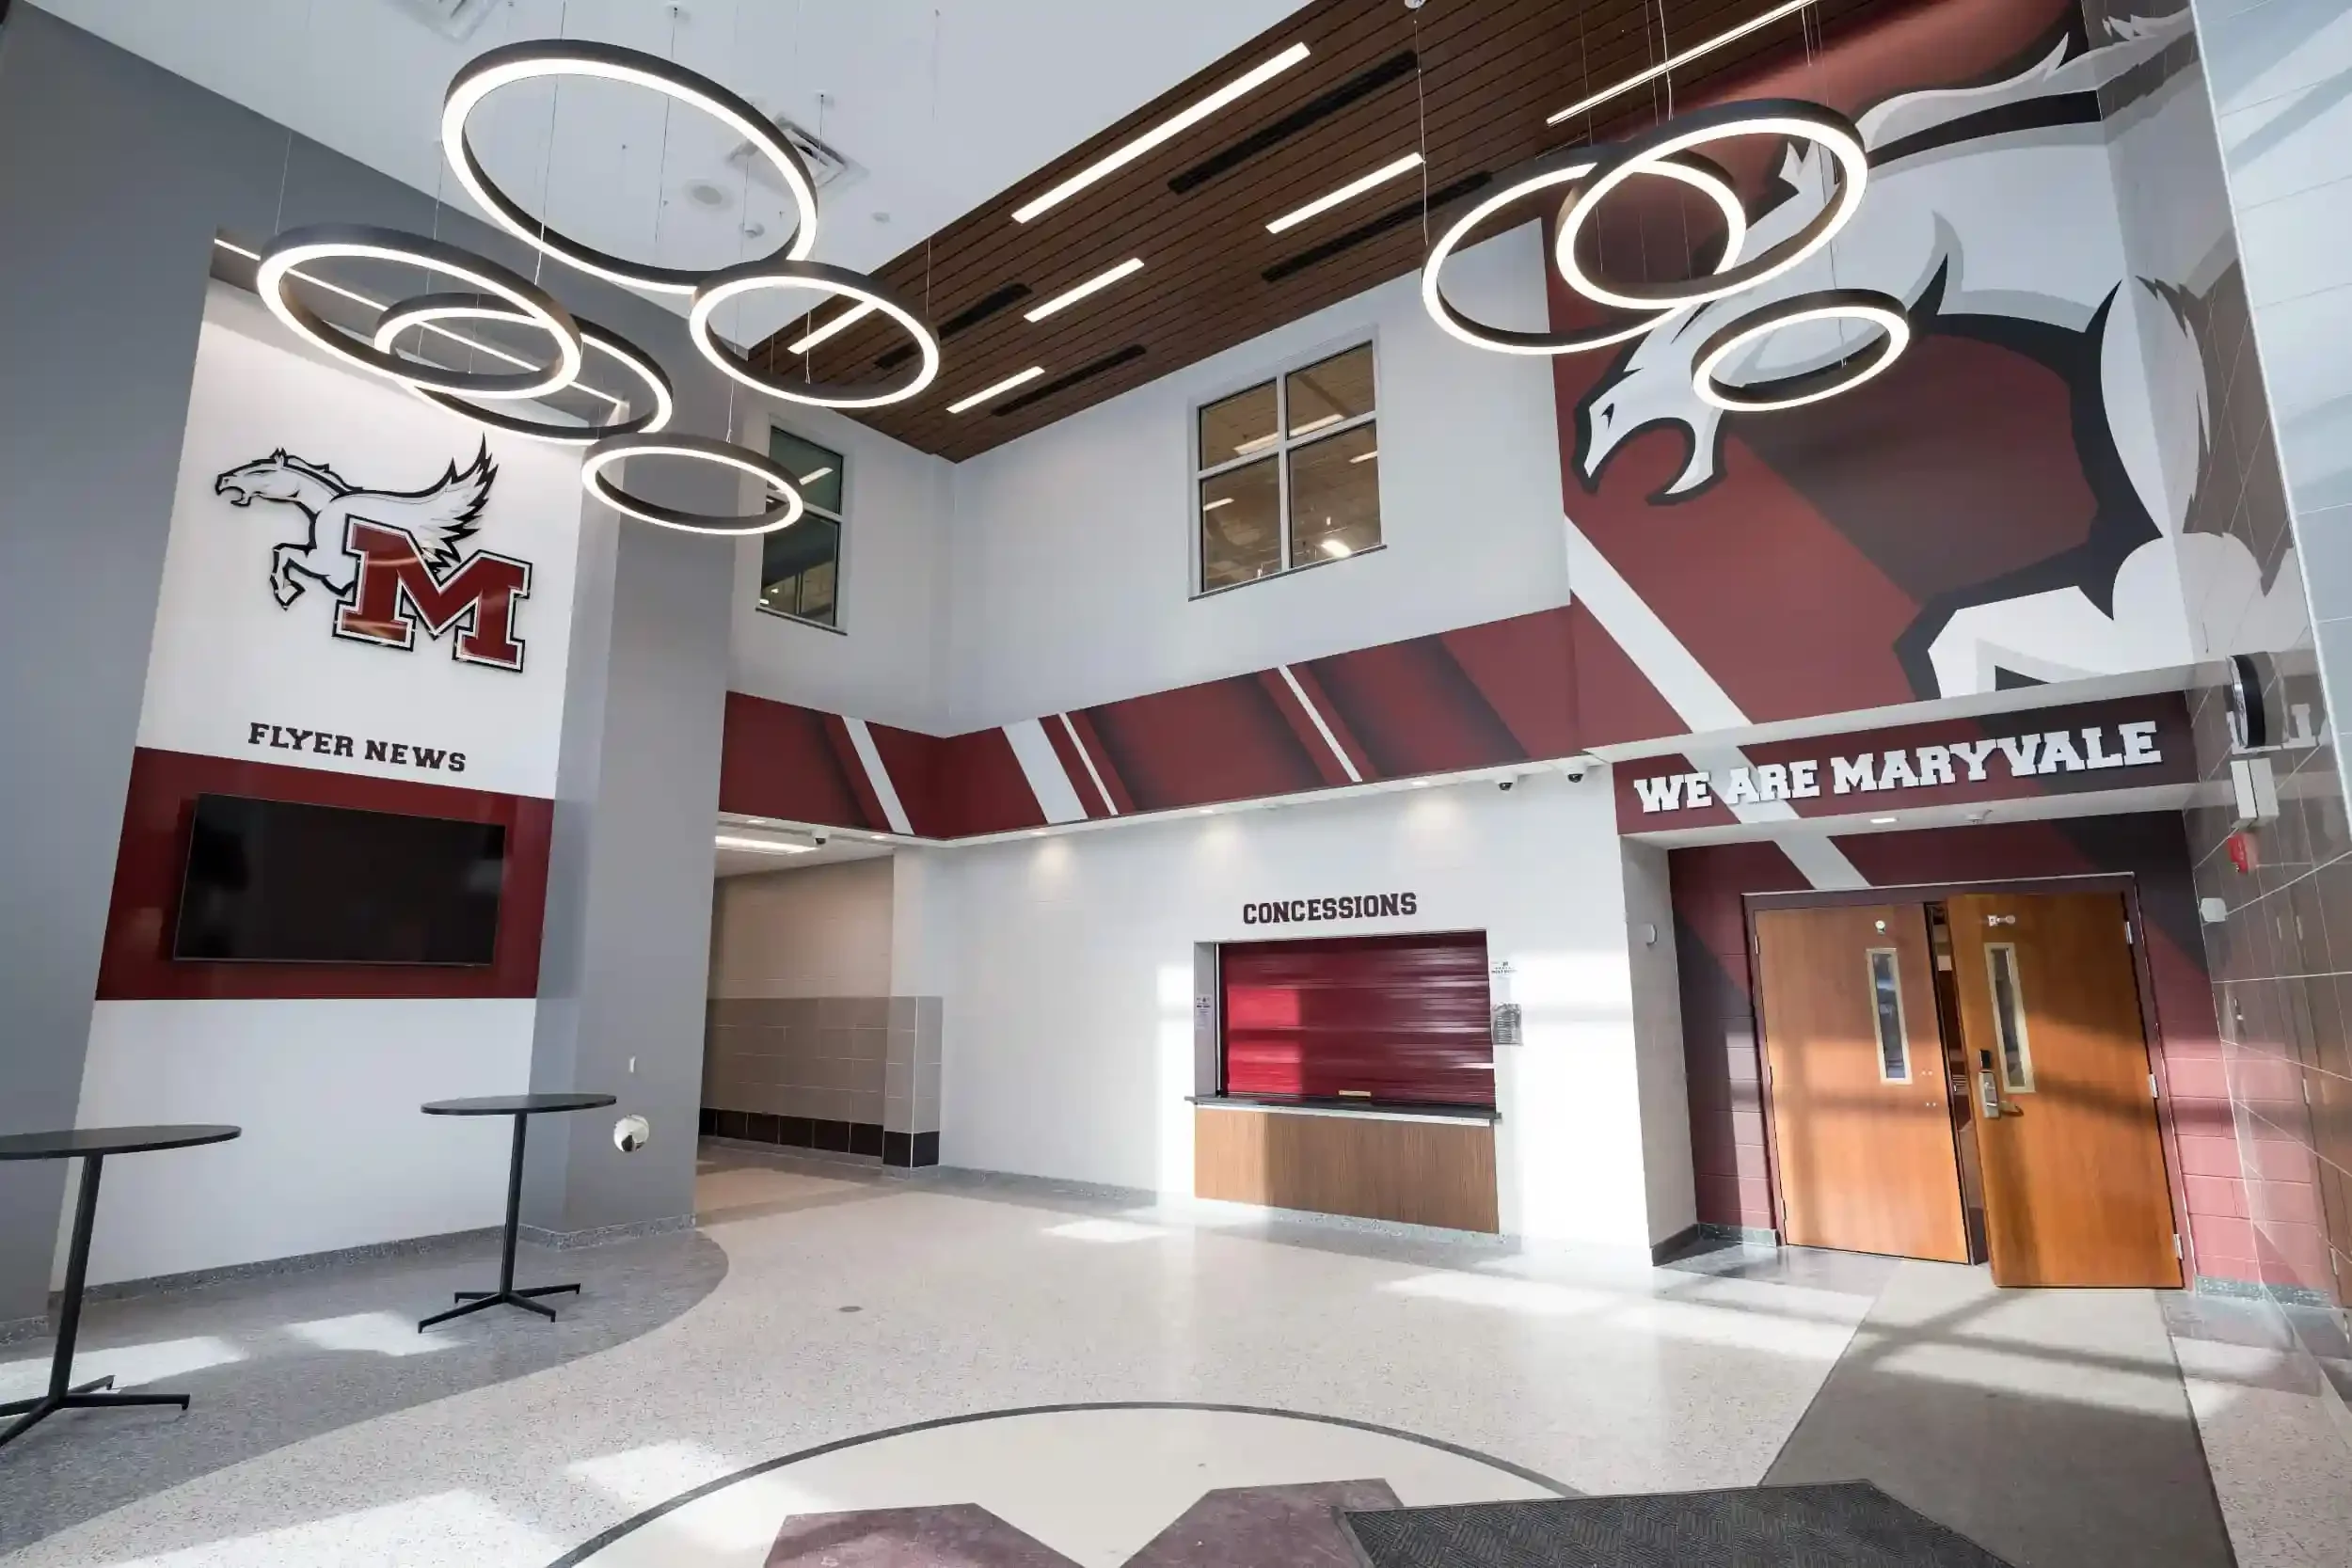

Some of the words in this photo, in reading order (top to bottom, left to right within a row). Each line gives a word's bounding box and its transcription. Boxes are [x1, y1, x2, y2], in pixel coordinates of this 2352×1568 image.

[332, 513, 533, 673] M
[248, 721, 354, 758] FLYER
[364, 738, 467, 772] NEWS
[1633, 771, 1712, 814] WE
[1724, 759, 1821, 805] ARE
[1830, 721, 2163, 796] MARYVALE
[1243, 892, 1418, 925] CONCESSIONS
